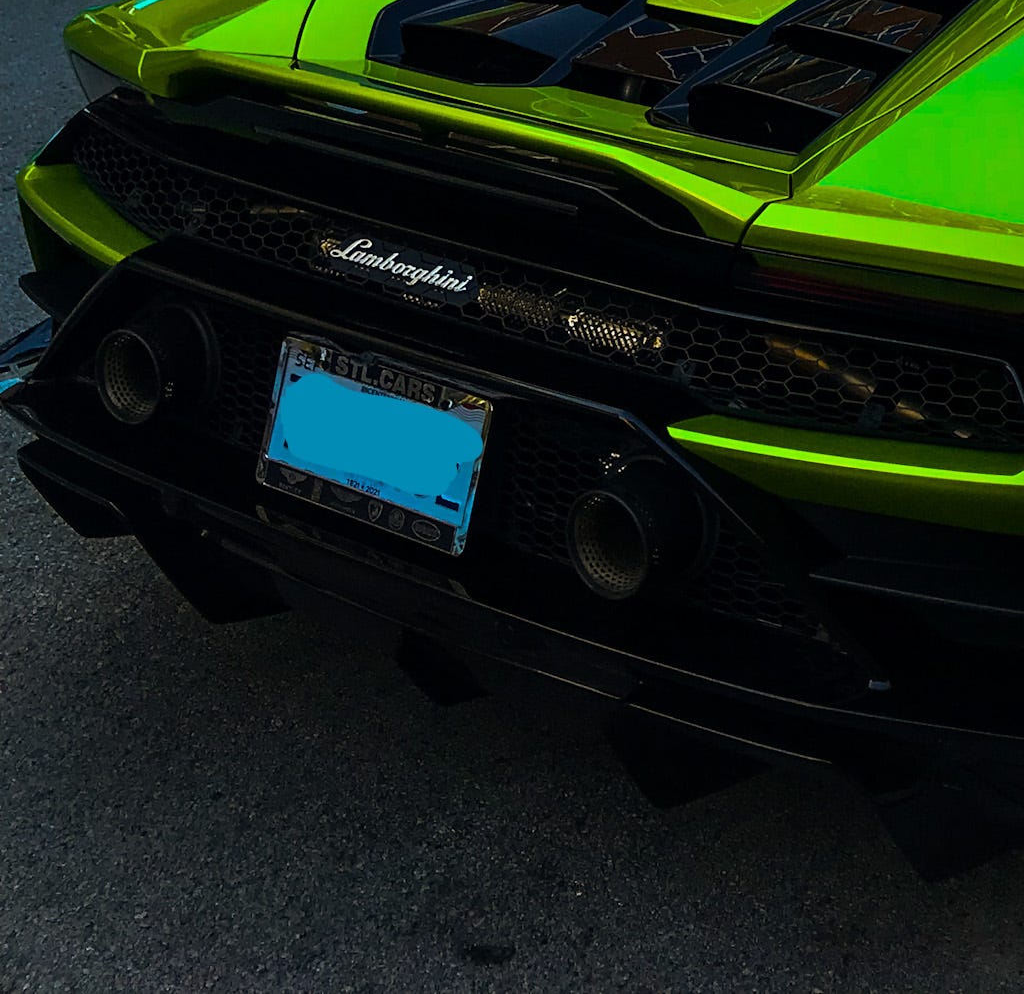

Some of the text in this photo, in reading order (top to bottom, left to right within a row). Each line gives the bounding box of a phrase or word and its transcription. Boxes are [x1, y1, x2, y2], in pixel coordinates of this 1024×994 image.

[329, 238, 473, 292] Lamborghini
[335, 355, 436, 405] STL.CARS
[364, 484, 382, 497] 2021
